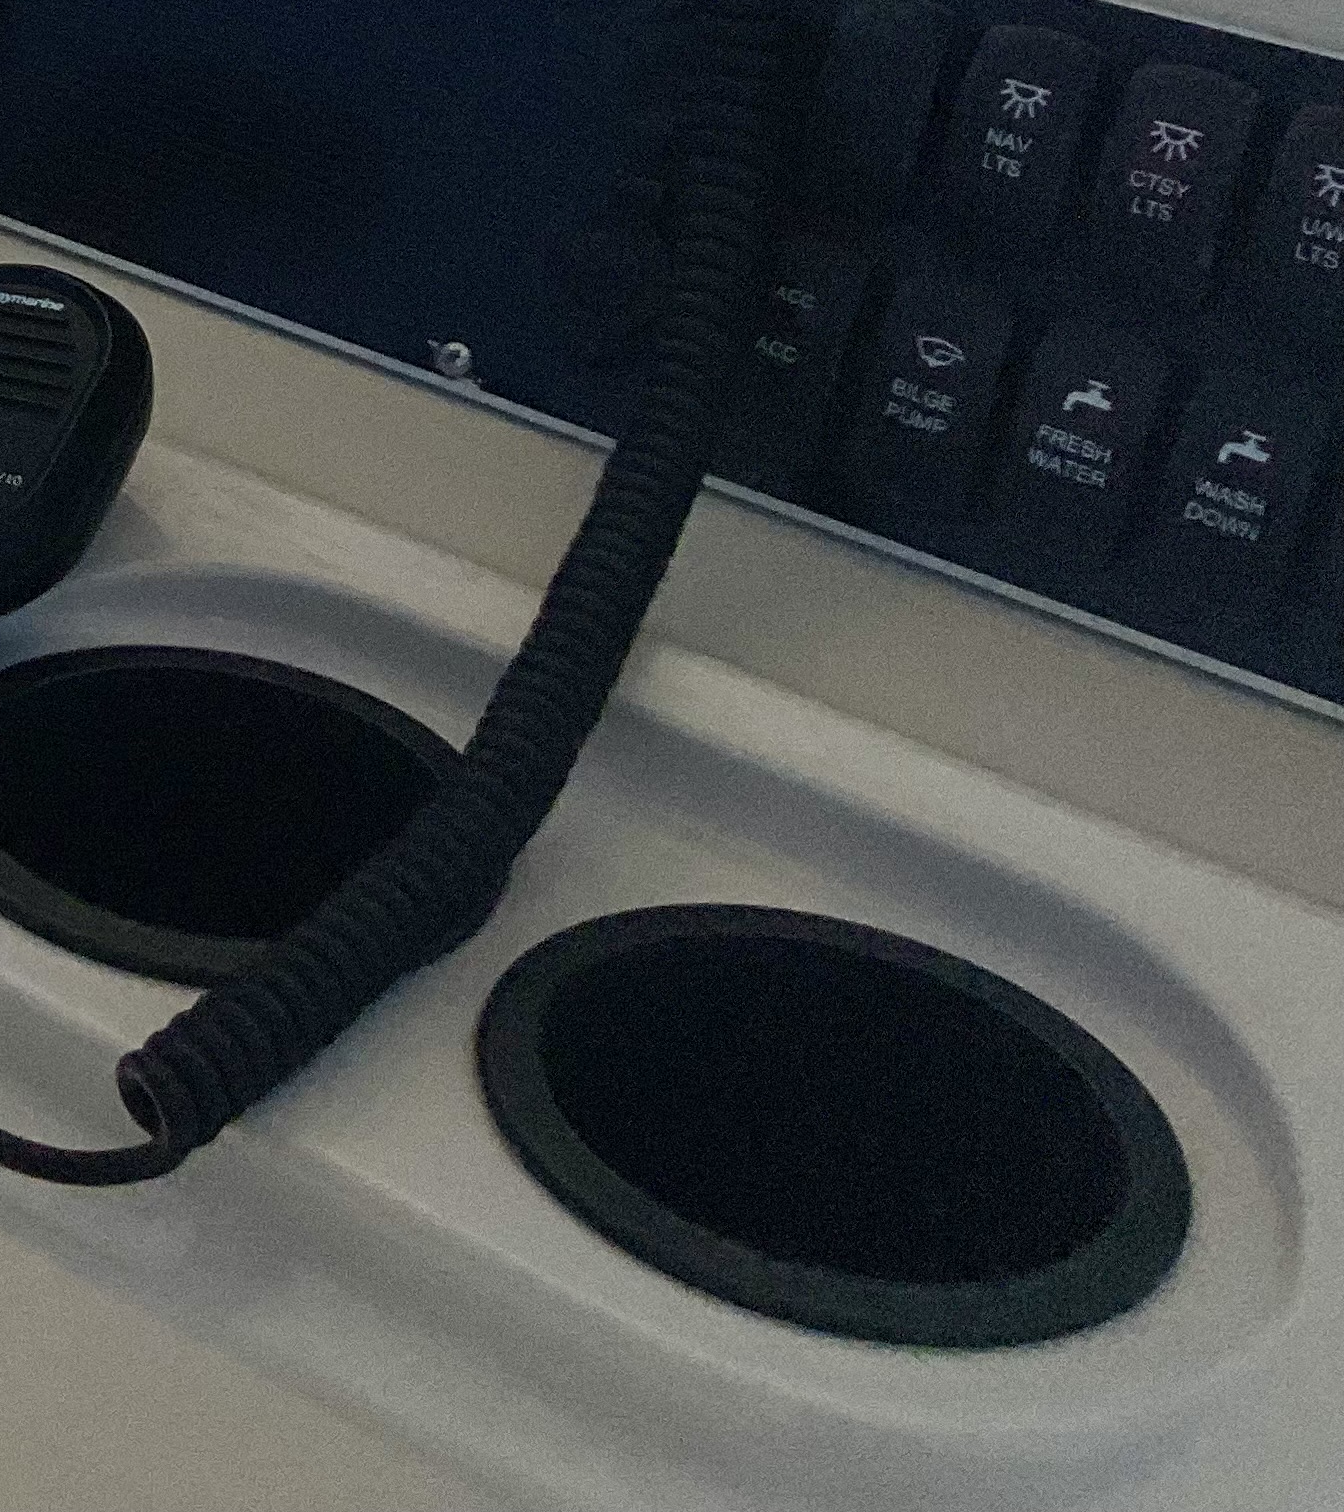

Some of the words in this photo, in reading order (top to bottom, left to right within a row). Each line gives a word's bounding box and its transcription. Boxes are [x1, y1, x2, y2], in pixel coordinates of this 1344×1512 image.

[985, 127, 1033, 152] NAV
[982, 152, 1022, 178] LTS
[1129, 170, 1191, 199] CTSY
[1131, 196, 1172, 222] LTS
[1295, 242, 1340, 269] LTS
[890, 378, 958, 415] BILGE
[881, 401, 947, 433] PUMP
[1037, 424, 1113, 464] FRESH
[1028, 446, 1106, 488] WATER
[1196, 477, 1265, 516] WASH
[1183, 501, 1260, 541] DOWN
